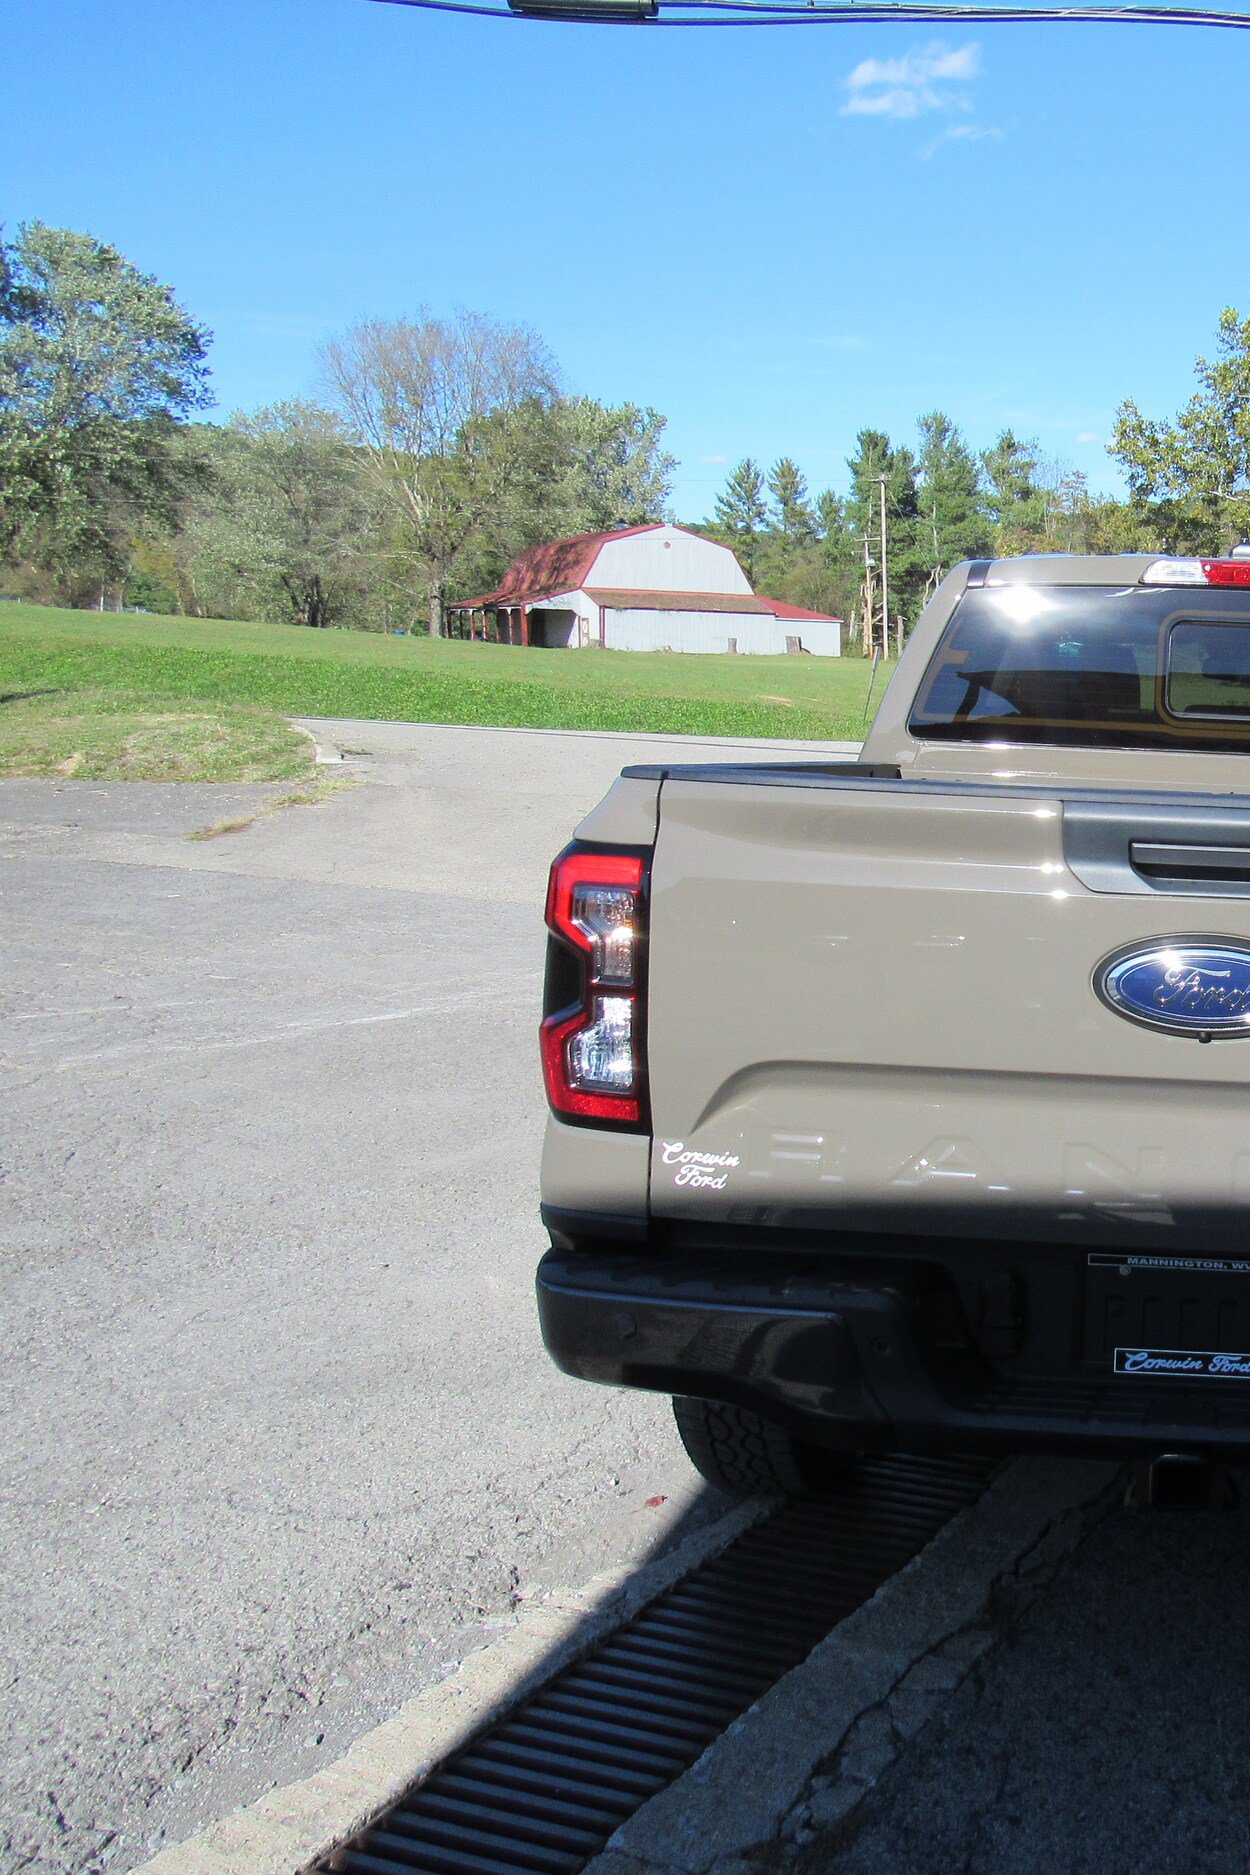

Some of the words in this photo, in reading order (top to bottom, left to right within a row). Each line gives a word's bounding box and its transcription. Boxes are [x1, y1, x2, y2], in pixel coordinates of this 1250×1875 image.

[662, 1141, 740, 1167] Corwin
[674, 1164, 728, 1189] Ford
[1124, 1352, 1203, 1371] Corwin
